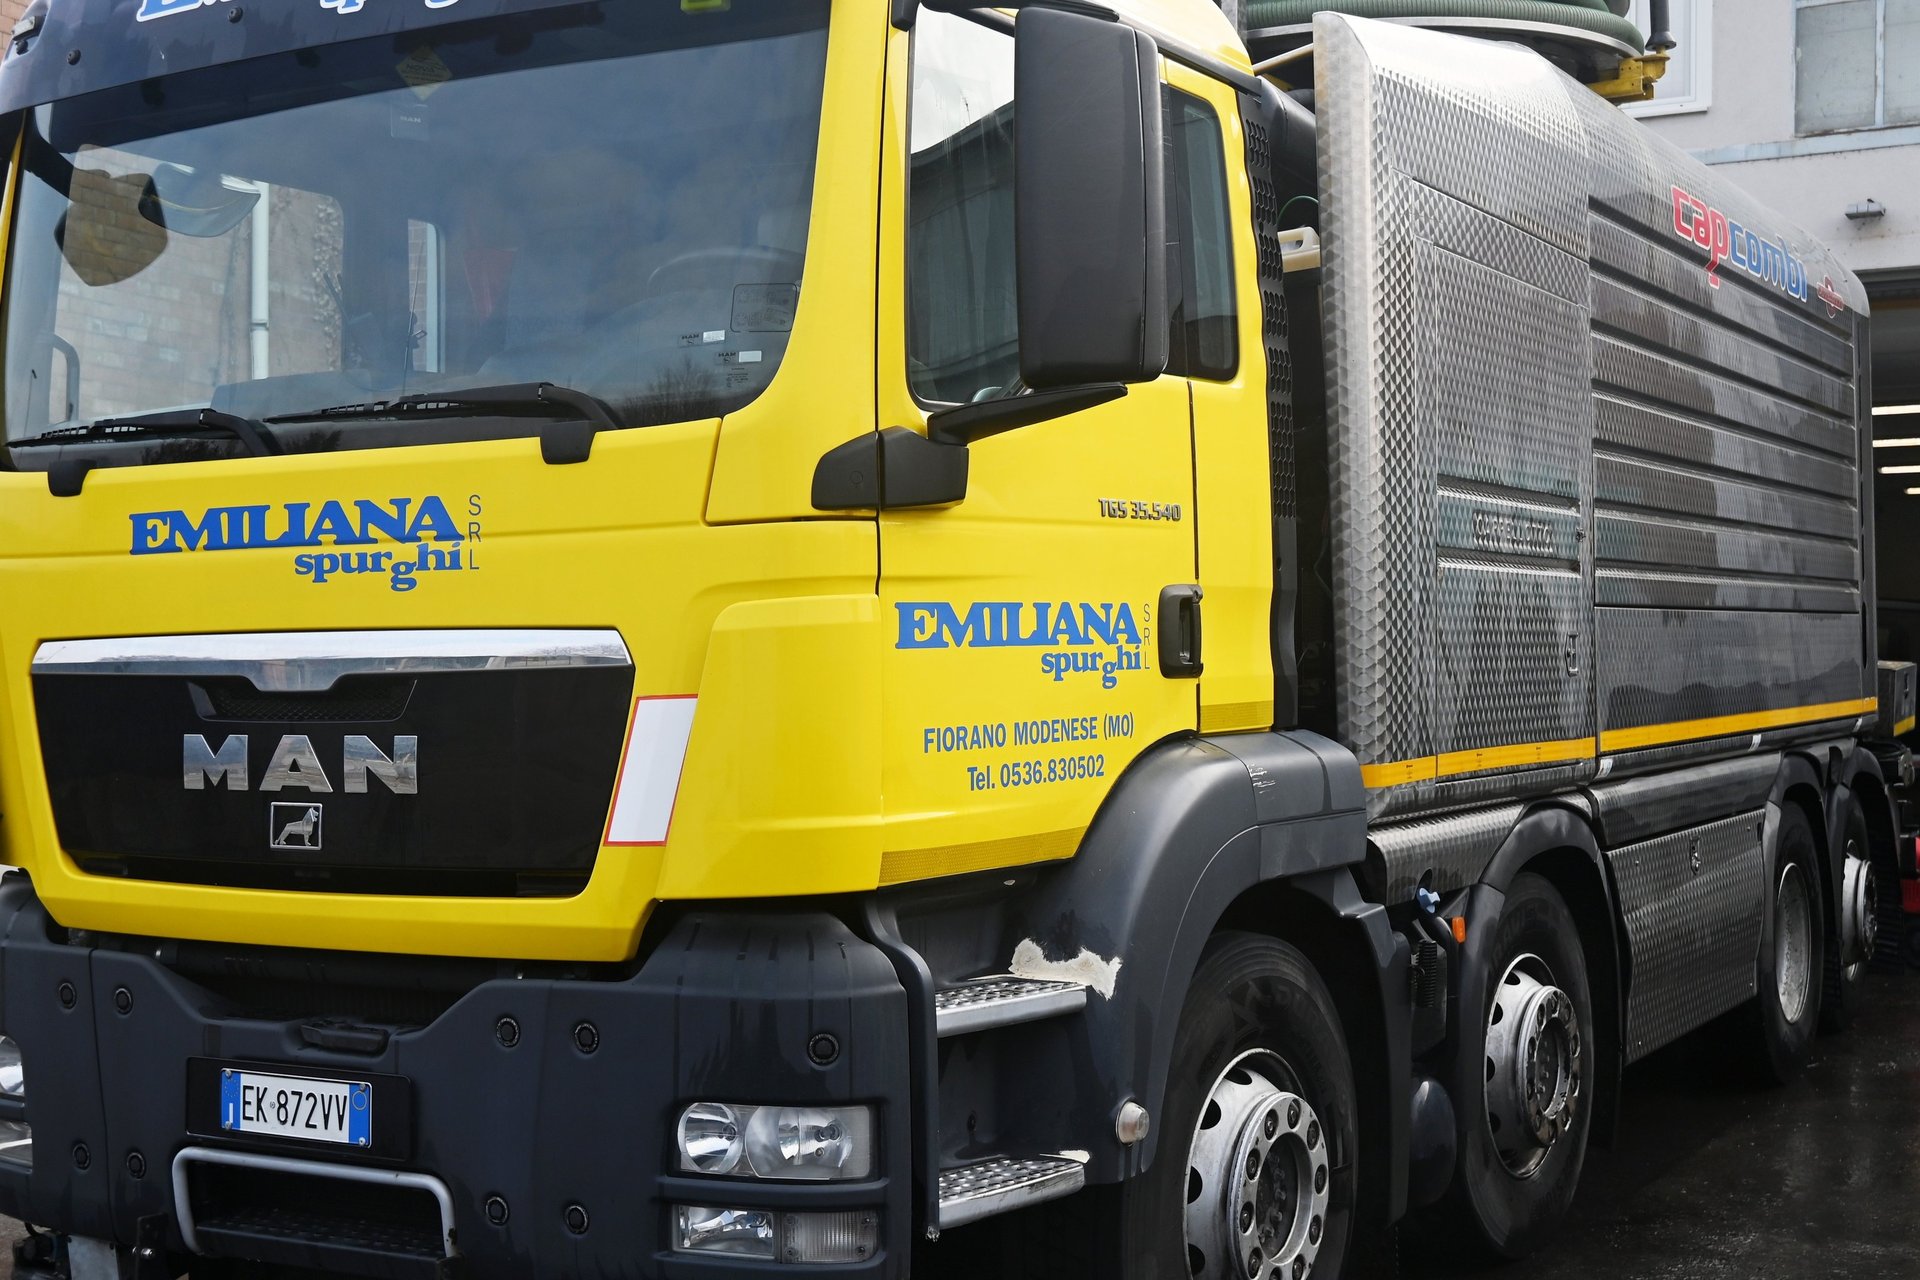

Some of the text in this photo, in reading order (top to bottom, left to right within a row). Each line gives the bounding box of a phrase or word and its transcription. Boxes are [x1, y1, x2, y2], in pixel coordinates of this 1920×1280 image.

[129, 495, 465, 555] EMILIANA
[1098, 498, 1181, 522] TGS 35.540
[294, 541, 463, 592] spurghi
[895, 601, 1142, 649] EMILIANA
[1041, 645, 1141, 690] spurghi
[923, 711, 1135, 754] FIORANO MODENESE (MO)
[182, 733, 418, 794] MAN
[967, 754, 1105, 791] Tel. 0536.830502
